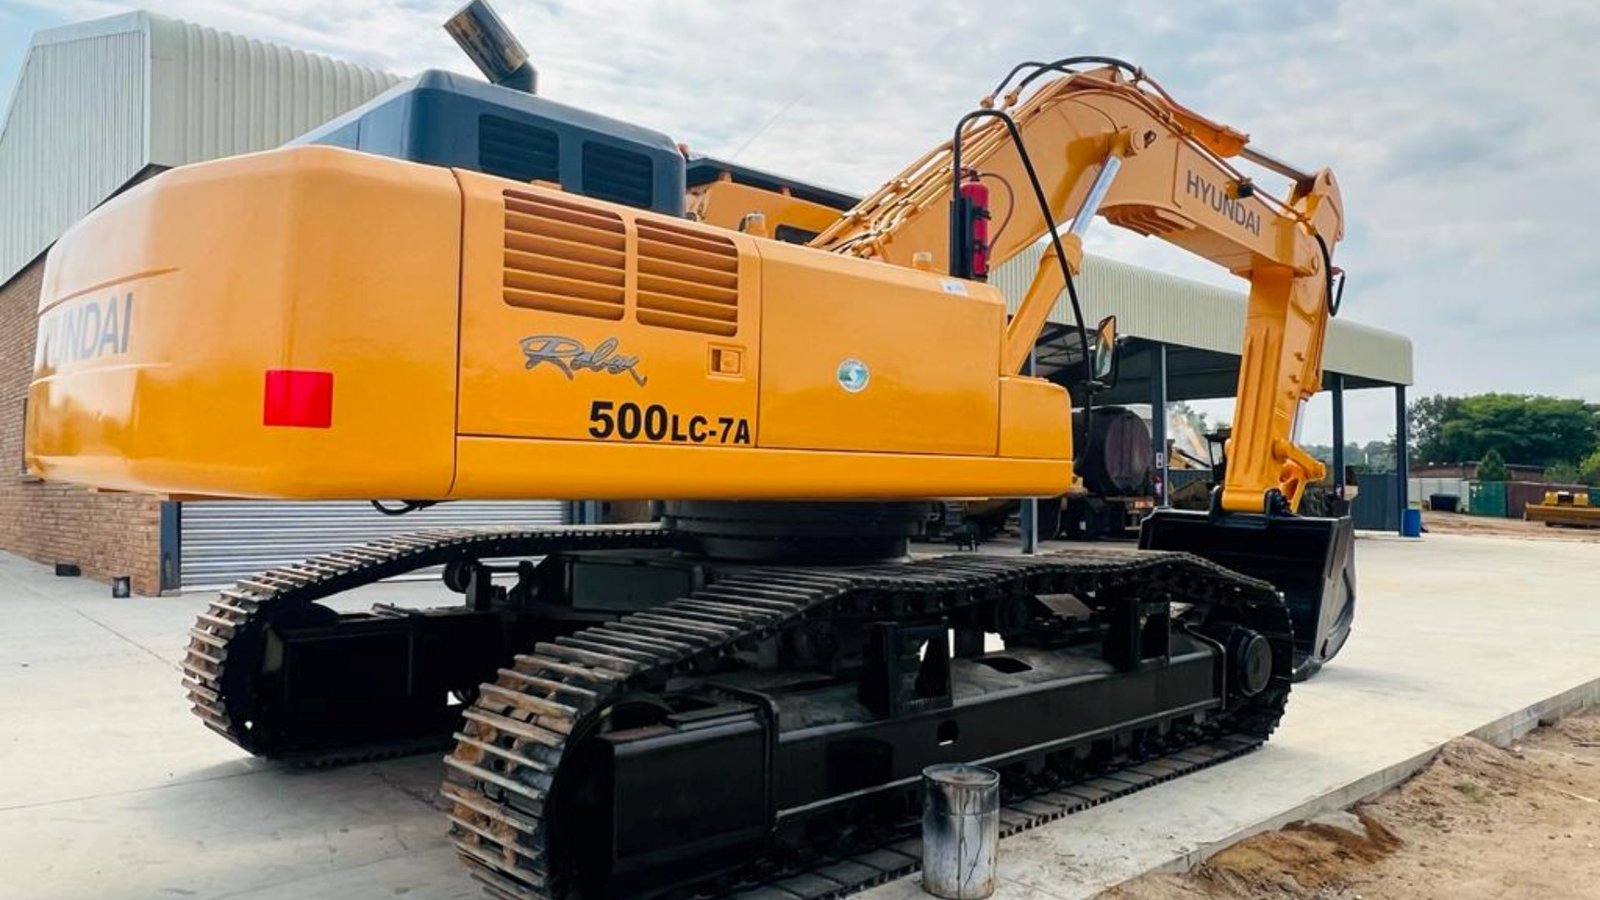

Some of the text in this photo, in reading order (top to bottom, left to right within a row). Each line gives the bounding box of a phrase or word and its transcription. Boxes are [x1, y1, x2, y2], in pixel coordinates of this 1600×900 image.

[1186, 169, 1260, 237] HYUNDAI
[519, 335, 648, 387] Robex
[588, 400, 750, 444] 500LC-7A
